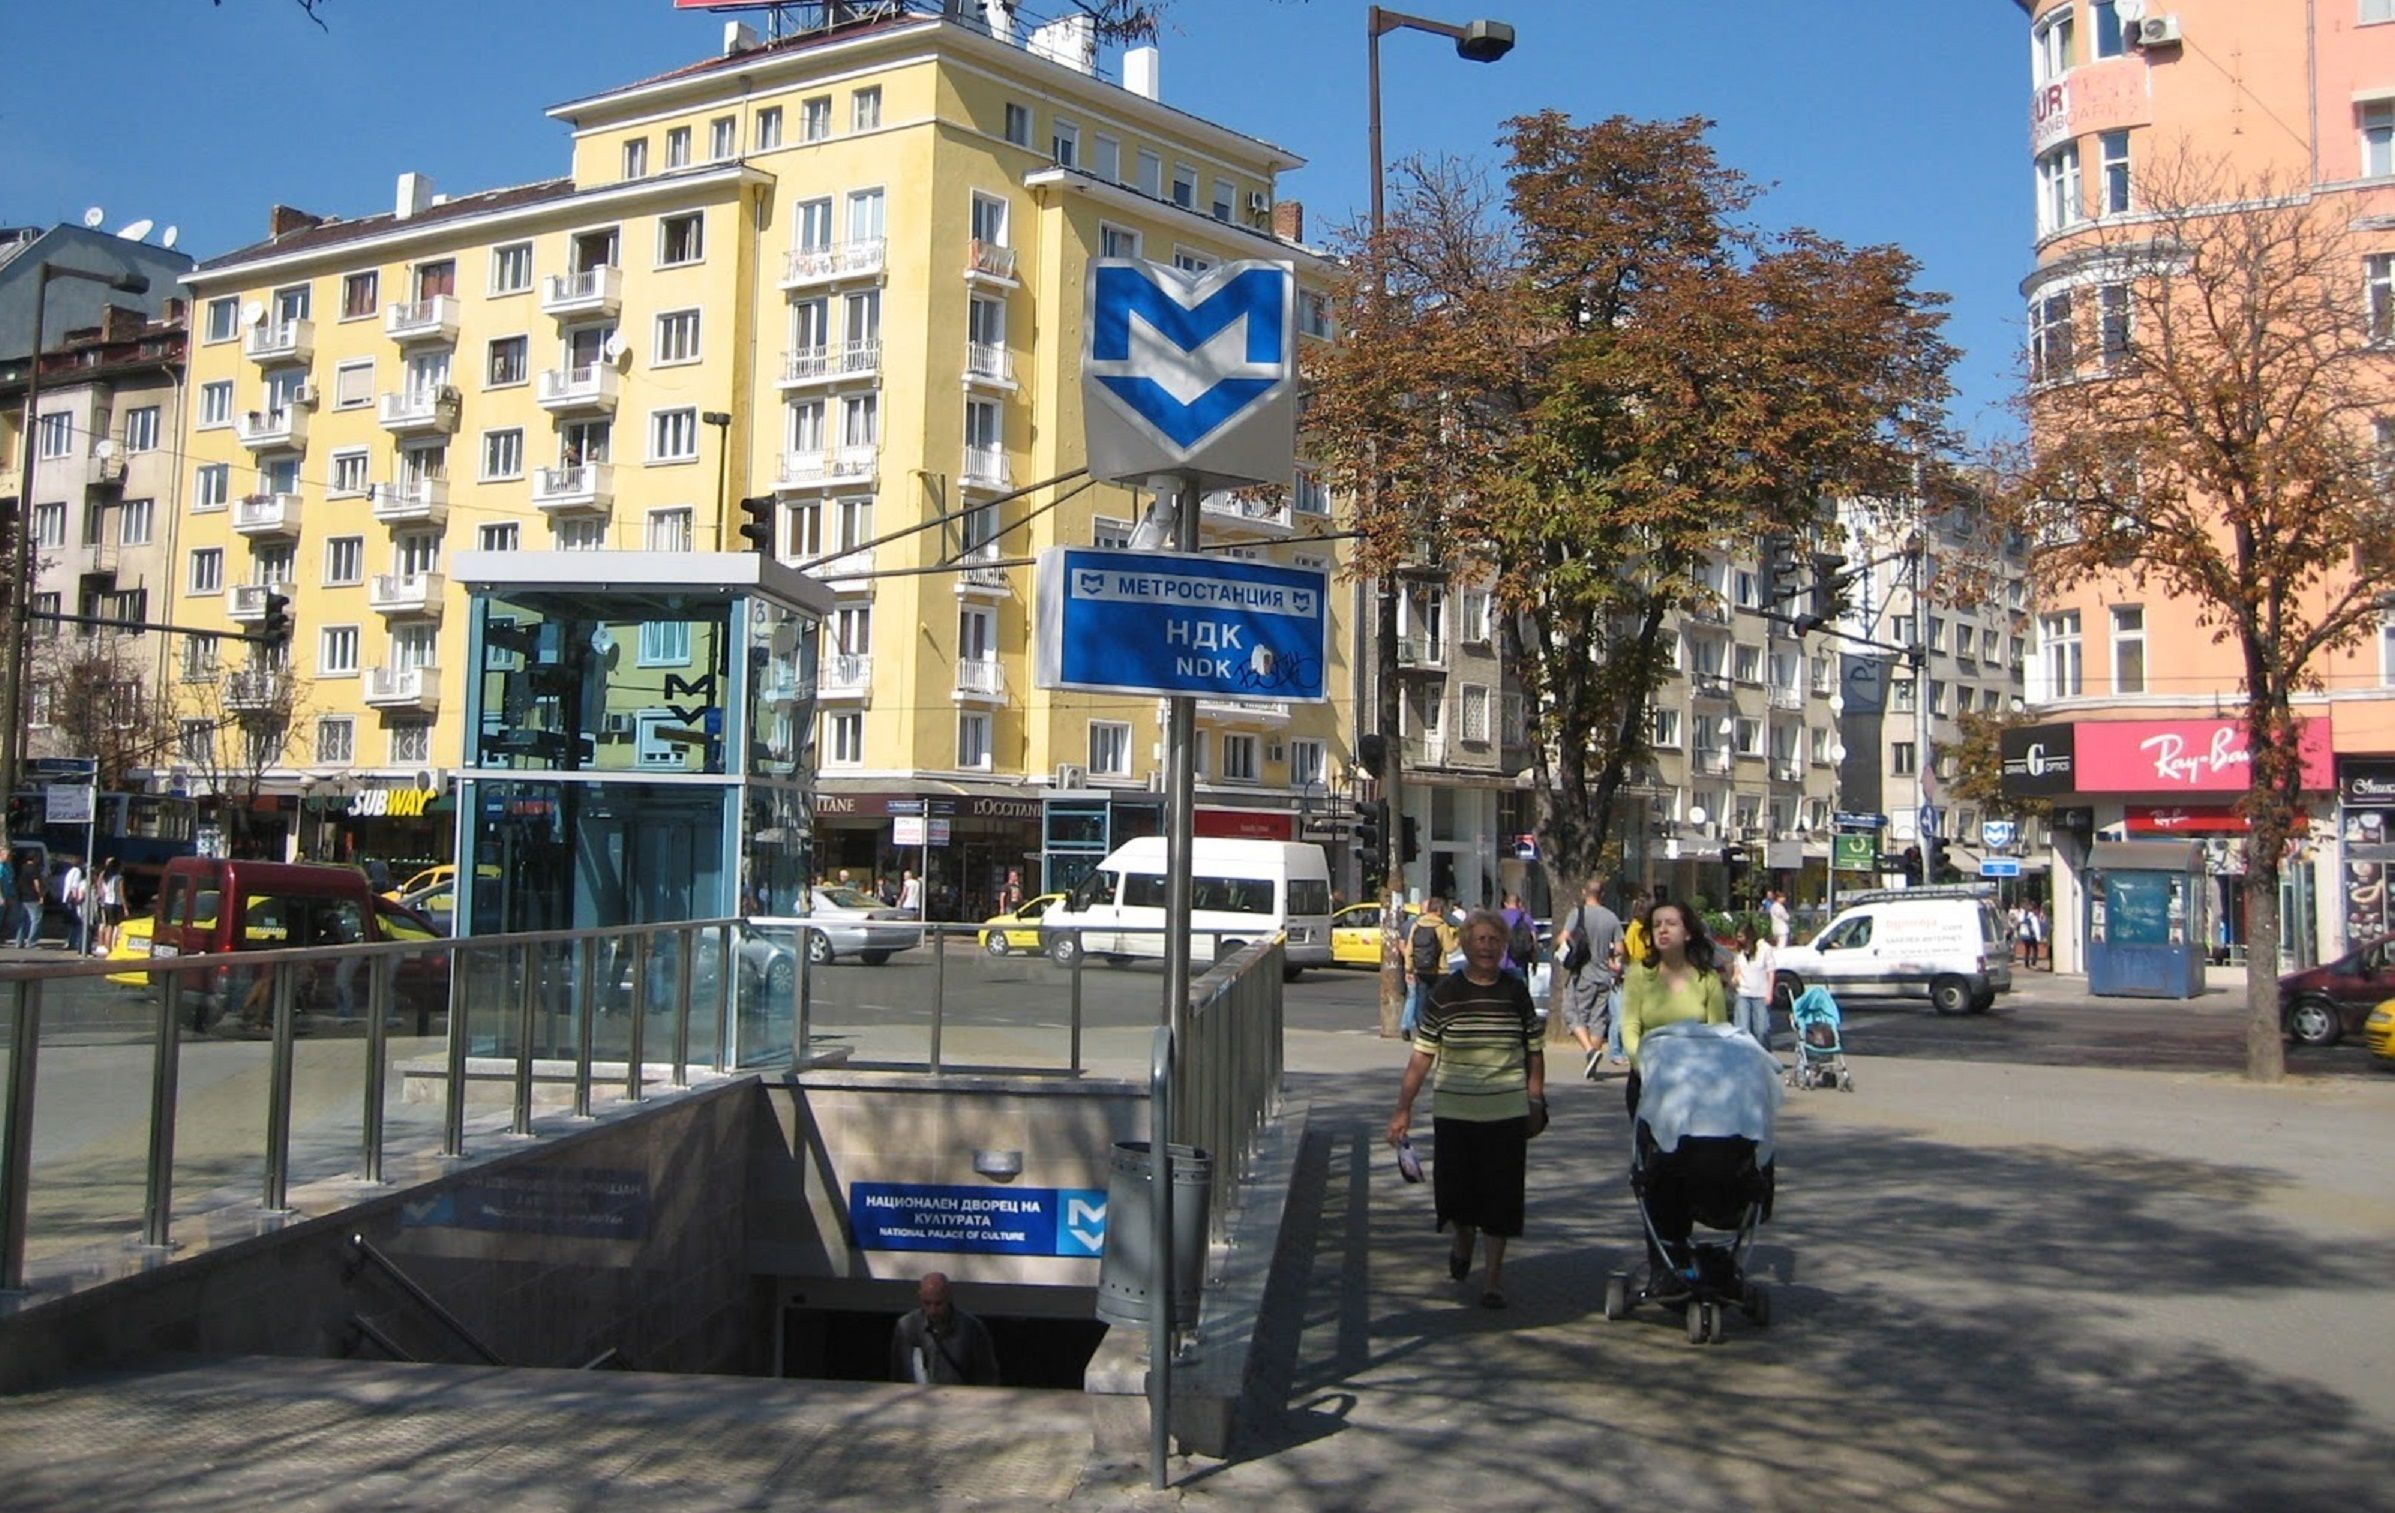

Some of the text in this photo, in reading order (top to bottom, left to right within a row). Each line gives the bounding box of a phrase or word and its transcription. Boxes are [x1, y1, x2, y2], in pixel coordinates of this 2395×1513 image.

[1118, 577, 1283, 608] МЕТРОСТАНЦИЯ
[1166, 618, 1243, 652] НДК
[1176, 656, 1232, 679] NDK
[347, 788, 437, 817] SUBWAY
[866, 1195, 1041, 1213] НАЦИОНАЛЕН ДВОРЕЦ НА
[914, 1213, 991, 1227] КУЛТУРАТА
[880, 1227, 1026, 1241] NATIONAL PALACE OF CULTURE
